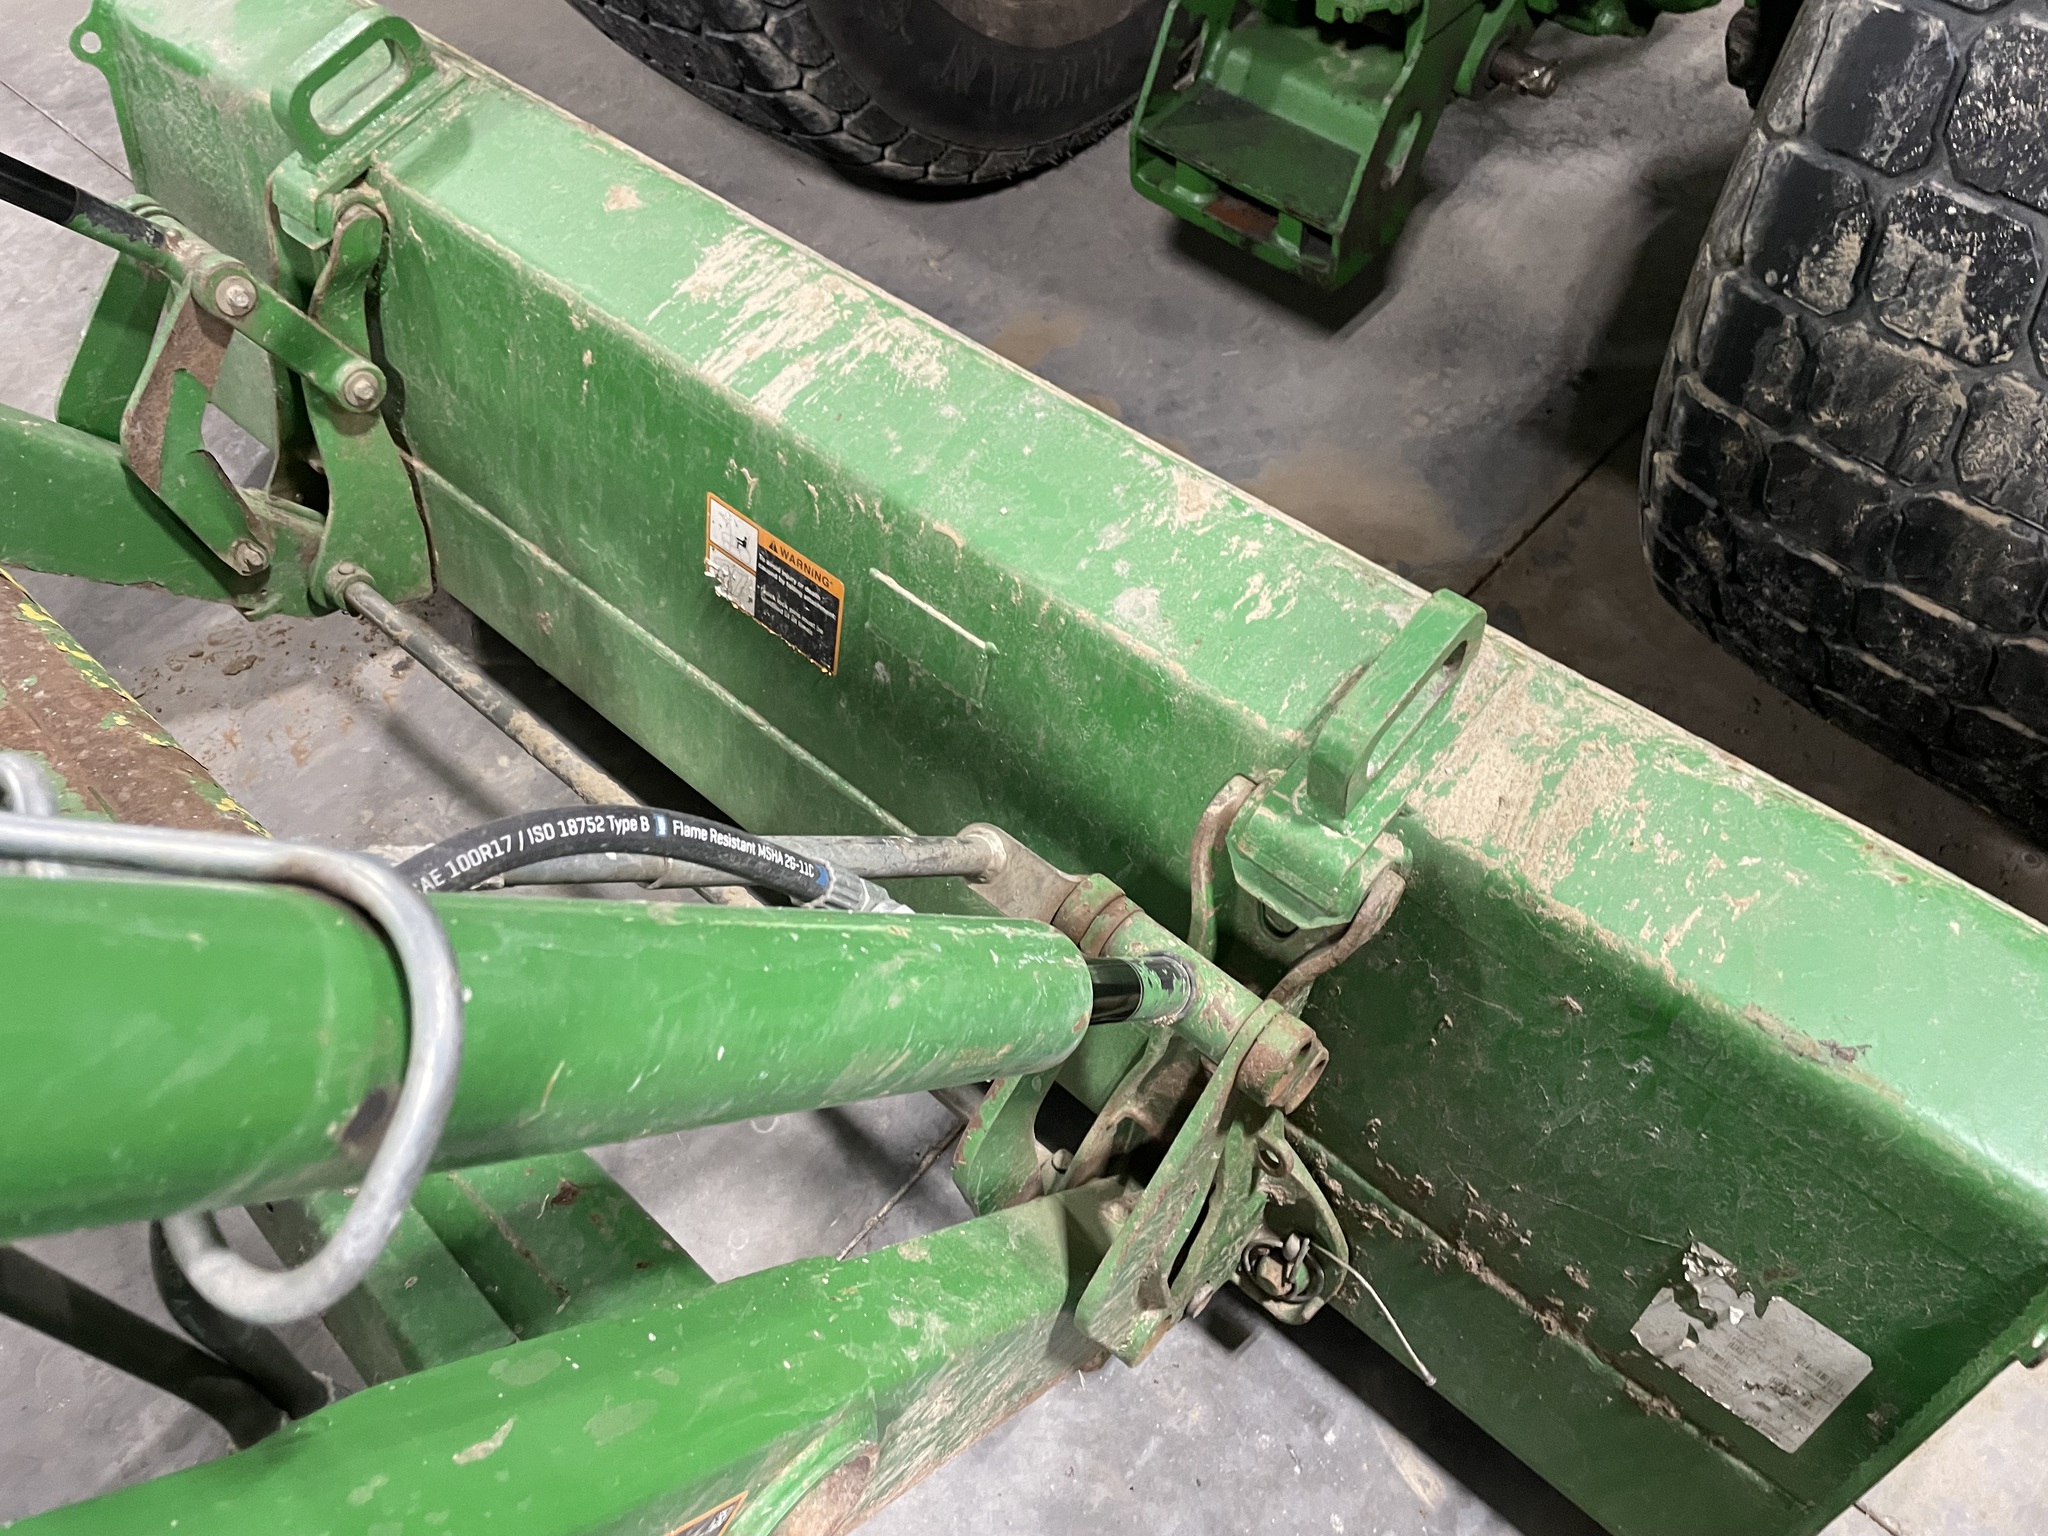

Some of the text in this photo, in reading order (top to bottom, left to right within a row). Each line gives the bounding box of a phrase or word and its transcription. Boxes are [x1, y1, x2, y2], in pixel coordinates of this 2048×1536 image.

[780, 546, 829, 588] WARNING
[413, 868, 446, 893] AE
[445, 834, 512, 878] 100R17
[527, 823, 555, 844] ISO
[557, 815, 605, 837] 18752
[606, 814, 638, 836] Type
[640, 815, 650, 832] B
[672, 819, 708, 841] Flame
[710, 827, 756, 855] Resistant
[757, 843, 783, 865] MSHA
